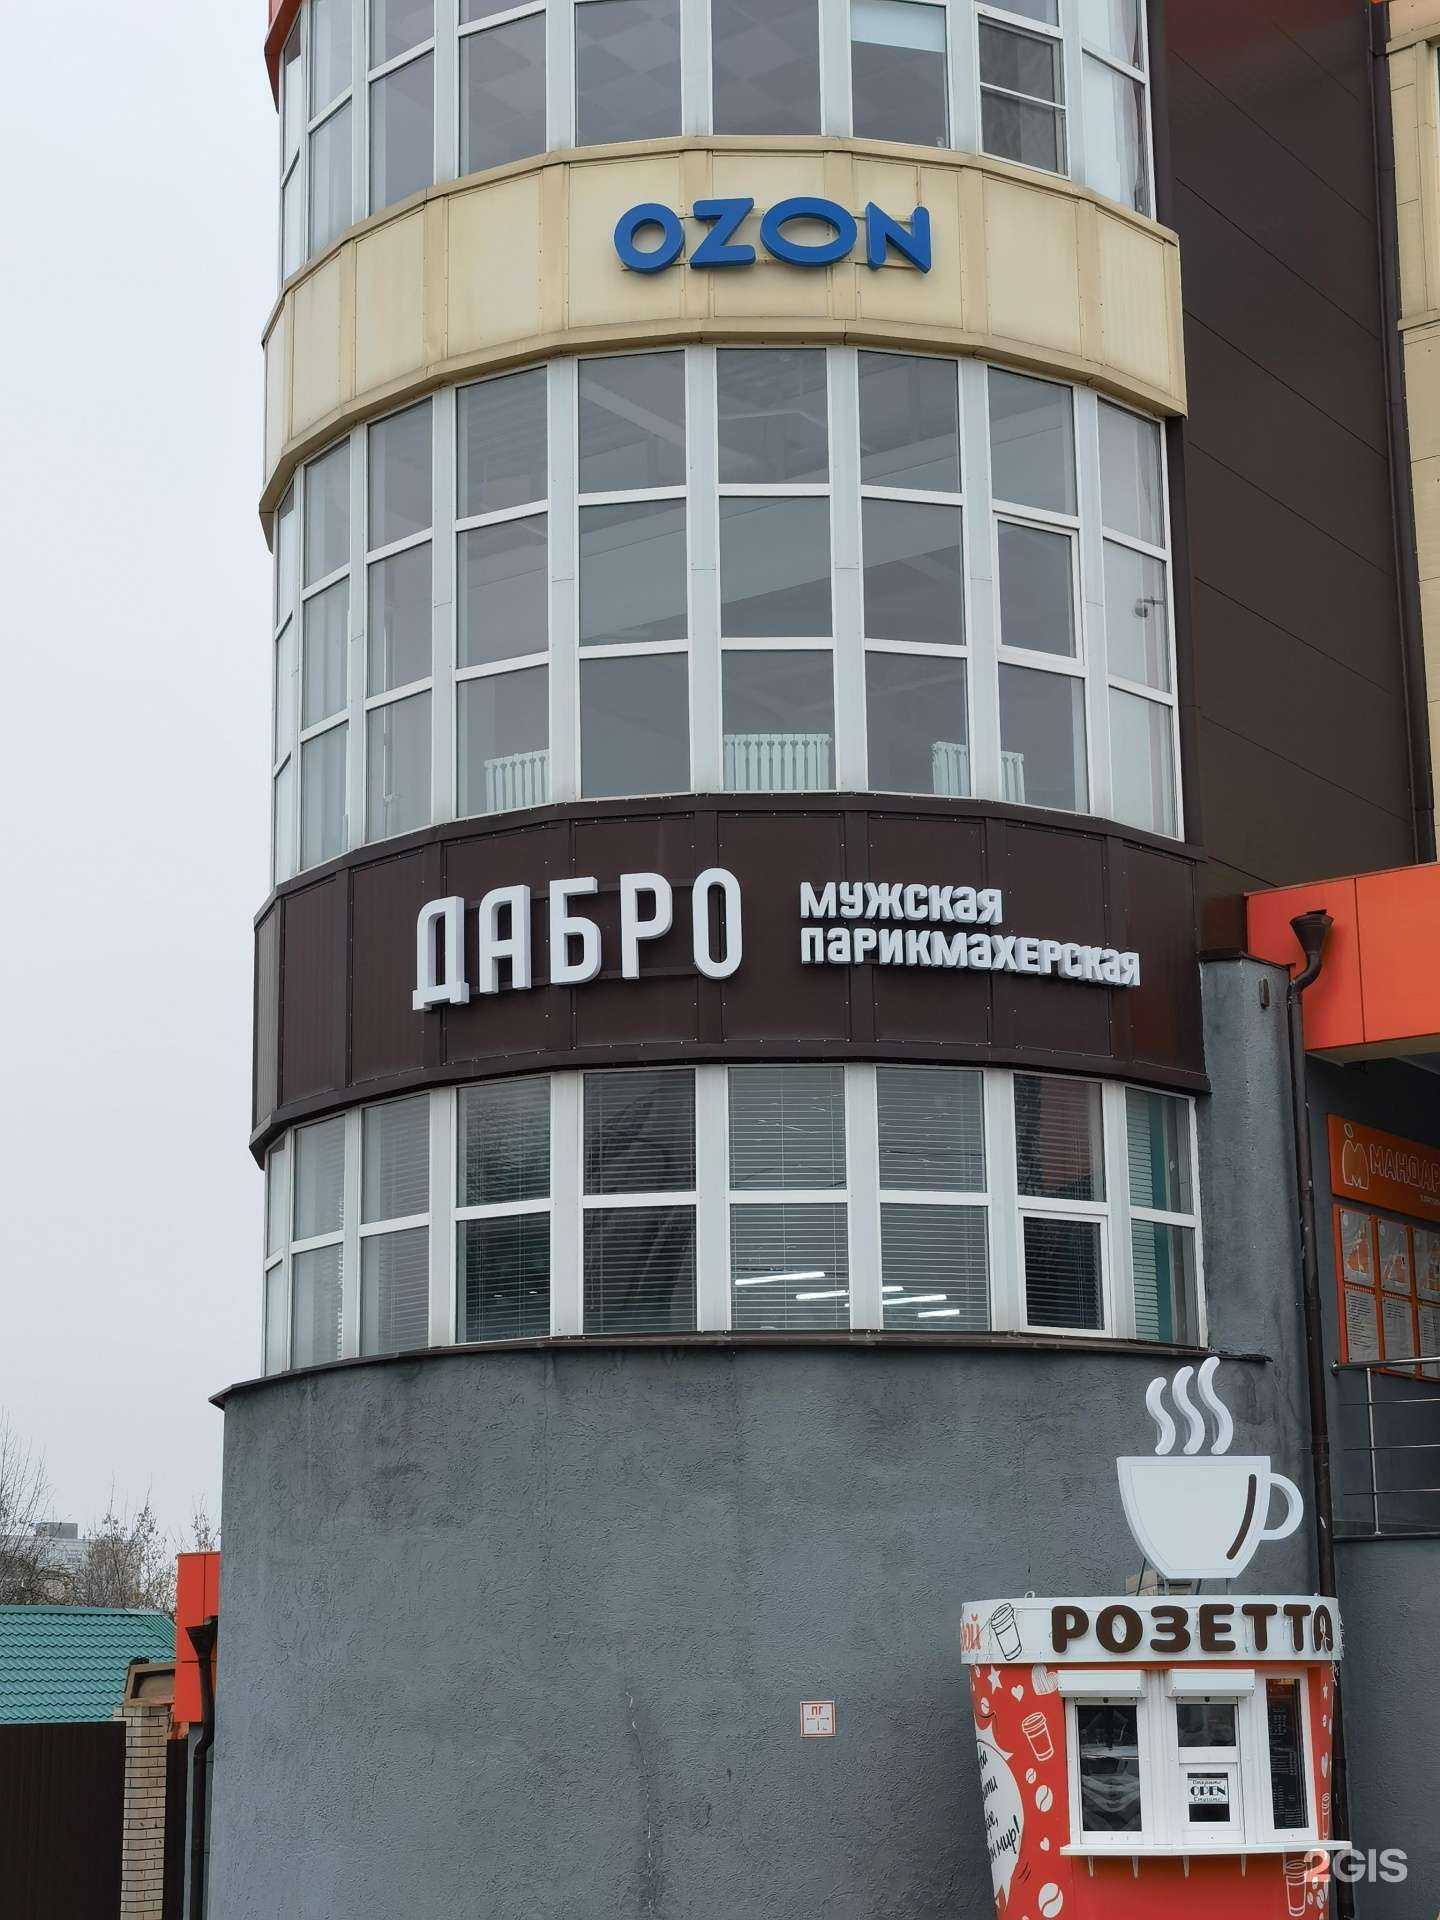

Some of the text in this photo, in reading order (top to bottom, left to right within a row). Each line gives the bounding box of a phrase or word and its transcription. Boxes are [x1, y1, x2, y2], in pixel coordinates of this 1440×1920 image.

[614, 196, 932, 274] OZON
[412, 867, 743, 1012] ДАБРО
[1050, 1603, 1334, 1653] РОЗЕТТА
[1190, 1785, 1227, 1797] OPEN
